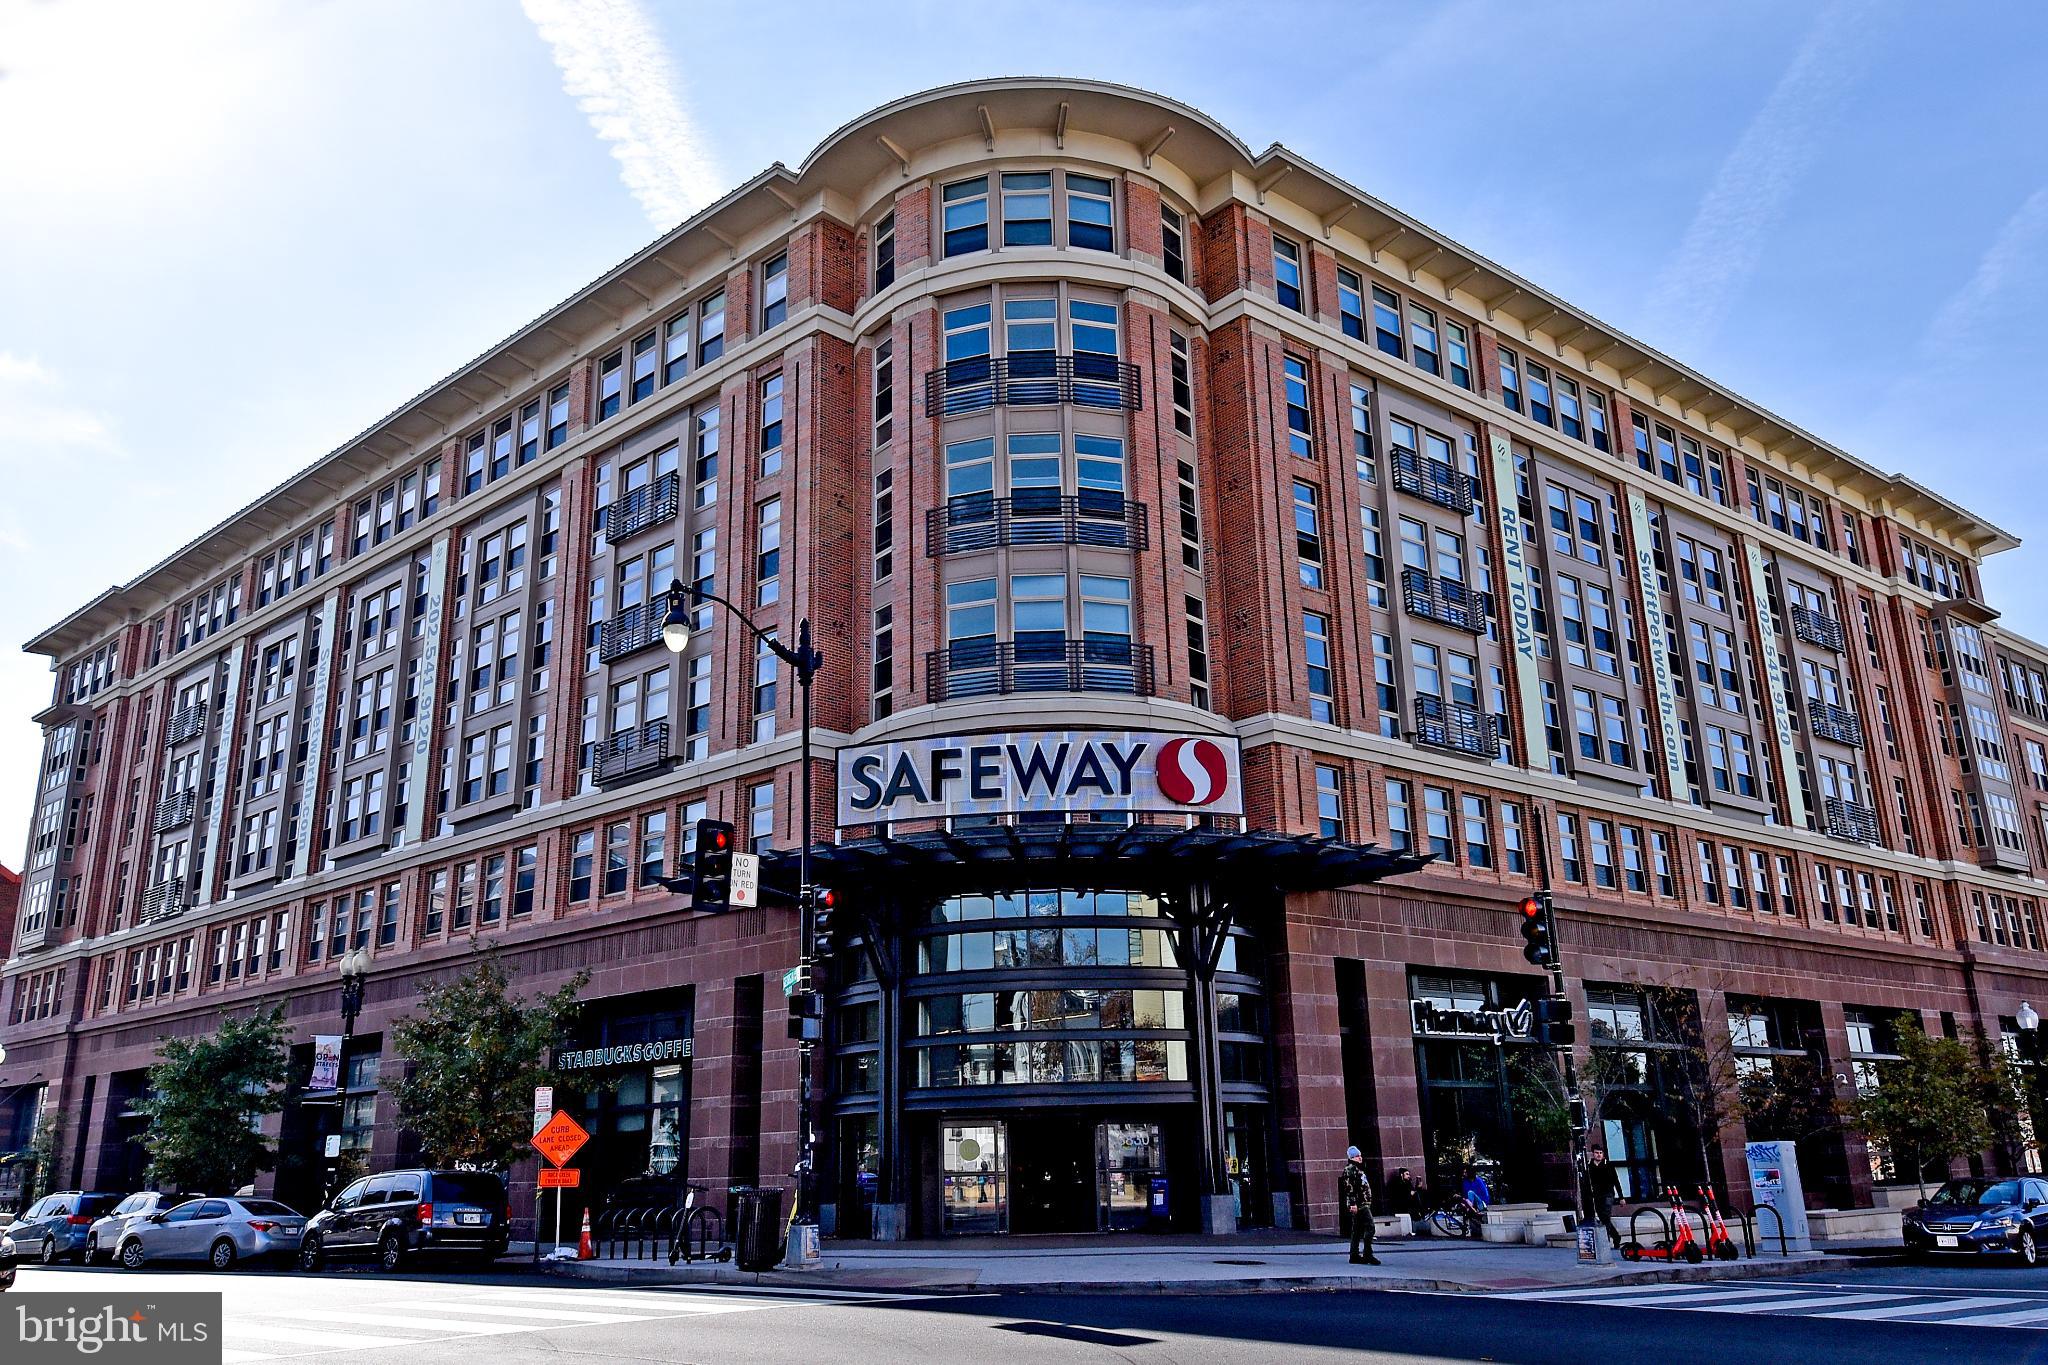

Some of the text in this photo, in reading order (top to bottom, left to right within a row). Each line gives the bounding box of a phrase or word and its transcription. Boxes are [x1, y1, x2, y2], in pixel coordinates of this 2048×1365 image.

[1501, 506, 1533, 662] RENT TODAY
[416, 594, 441, 754] 202.541.9120
[1639, 549, 1681, 772] SwiftPetworth.com
[1757, 595, 1791, 746] 202.541.9120
[210, 693, 236, 829] MOVE IN NOW
[298, 649, 331, 851] SwiftPetworth.com
[850, 740, 1150, 811] SAFEWAY
[733, 868, 751, 879] TURN
[735, 857, 749, 867] NO
[740, 880, 754, 889] RED
[558, 1038, 694, 1070] STARBUCKS COFFE
[540, 1134, 582, 1144] LANE CLOSED
[550, 1126, 570, 1134] CURB
[550, 1144, 570, 1152] AHEAD
